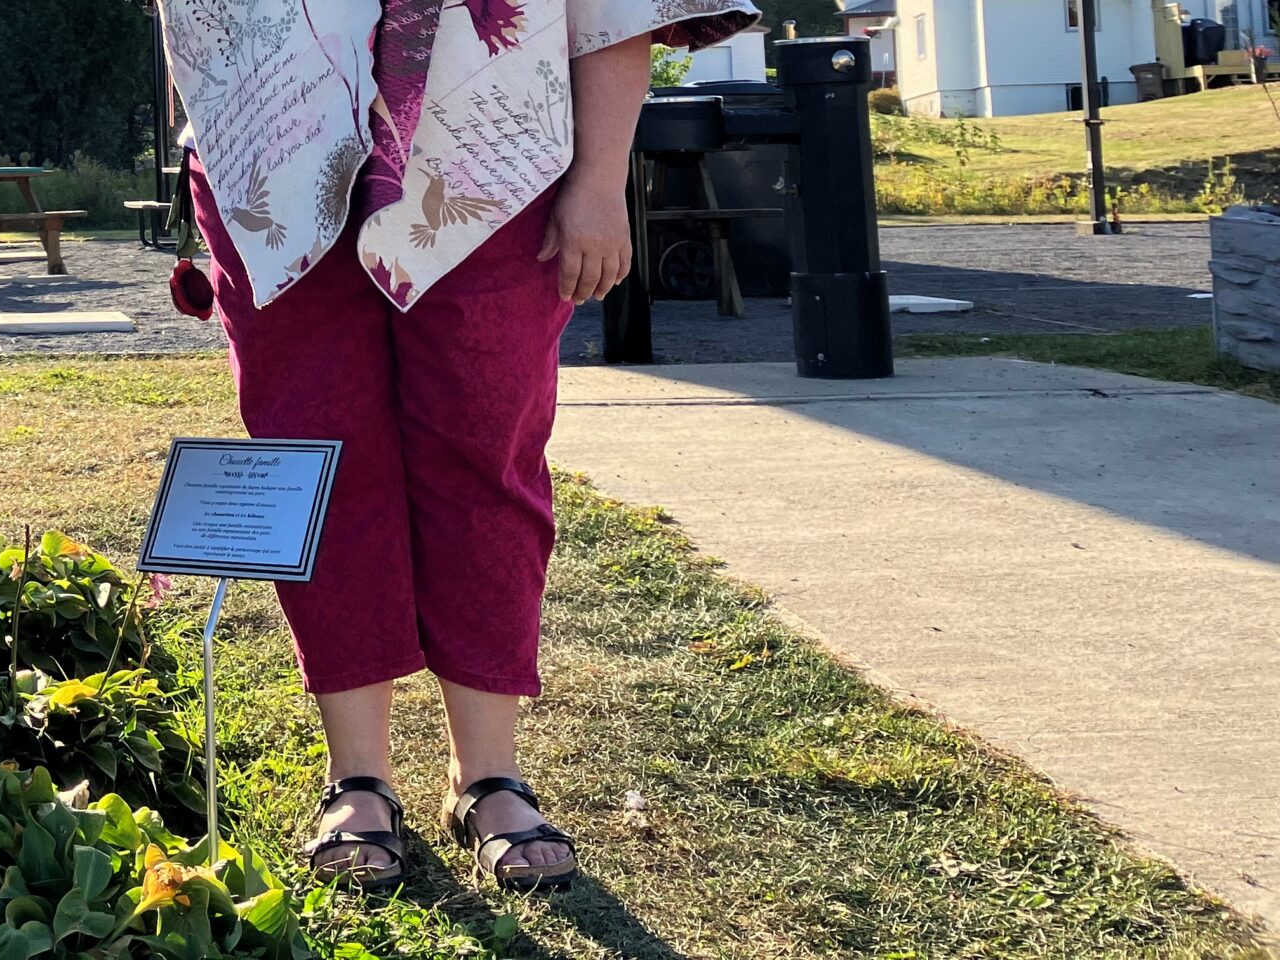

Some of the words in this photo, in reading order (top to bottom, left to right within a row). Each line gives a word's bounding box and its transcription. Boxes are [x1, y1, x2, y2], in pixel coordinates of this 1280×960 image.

[257, 63, 281, 93] about
[282, 51, 298, 68] me
[319, 66, 336, 83] me
[255, 88, 281, 115] about
[281, 74, 297, 90] me
[469, 90, 507, 136] Thaks
[427, 99, 465, 144] Thanks
[479, 158, 527, 206] everythin
[465, 113, 503, 158] Thanks
[251, 456, 280, 470] famille
